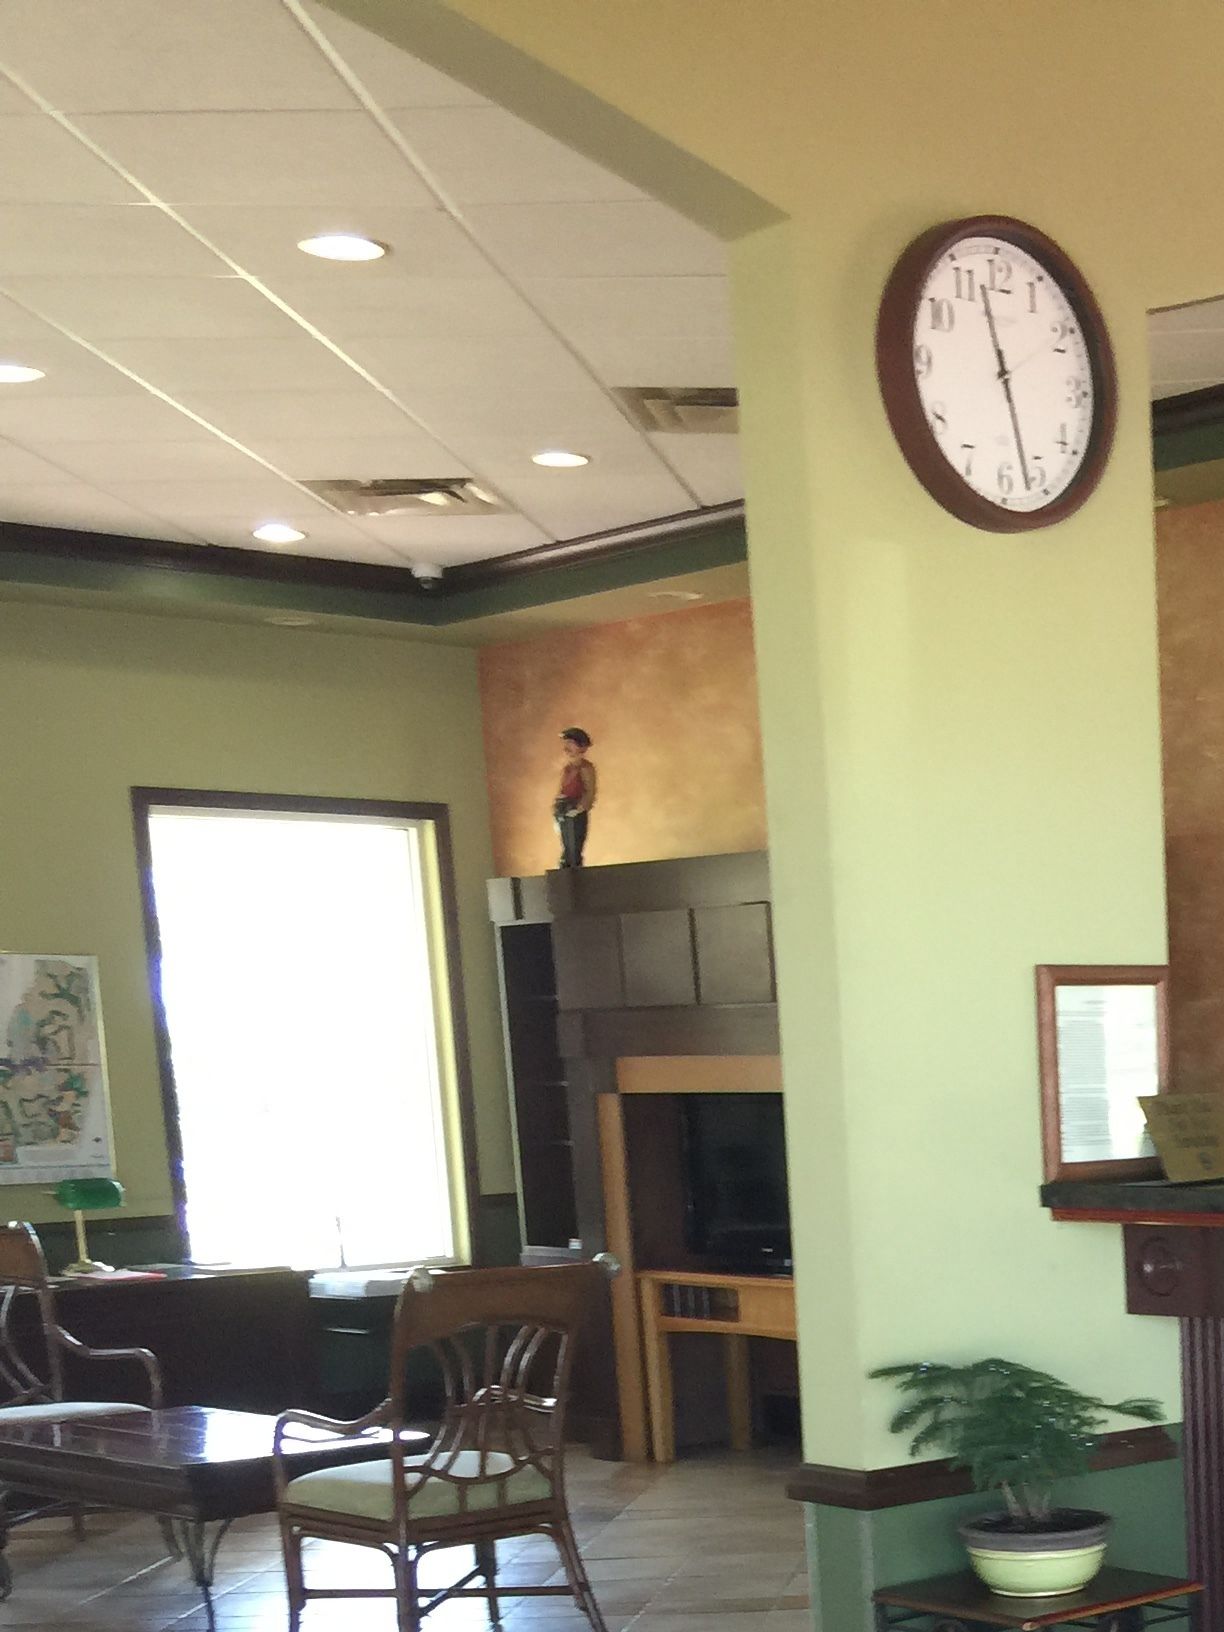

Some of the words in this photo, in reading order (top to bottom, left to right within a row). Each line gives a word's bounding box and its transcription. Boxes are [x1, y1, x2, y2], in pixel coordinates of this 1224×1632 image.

[953, 267, 975, 302] 11
[987, 259, 1013, 295] 12
[1026, 282, 1037, 313] 1
[928, 297, 955, 332] 10
[1052, 323, 1068, 354] 2
[914, 344, 932, 379] 9
[1066, 376, 1083, 408] 3
[1055, 423, 1069, 454] 4
[961, 443, 975, 476] 7
[1030, 454, 1047, 488] 5
[997, 464, 1014, 495] 6
